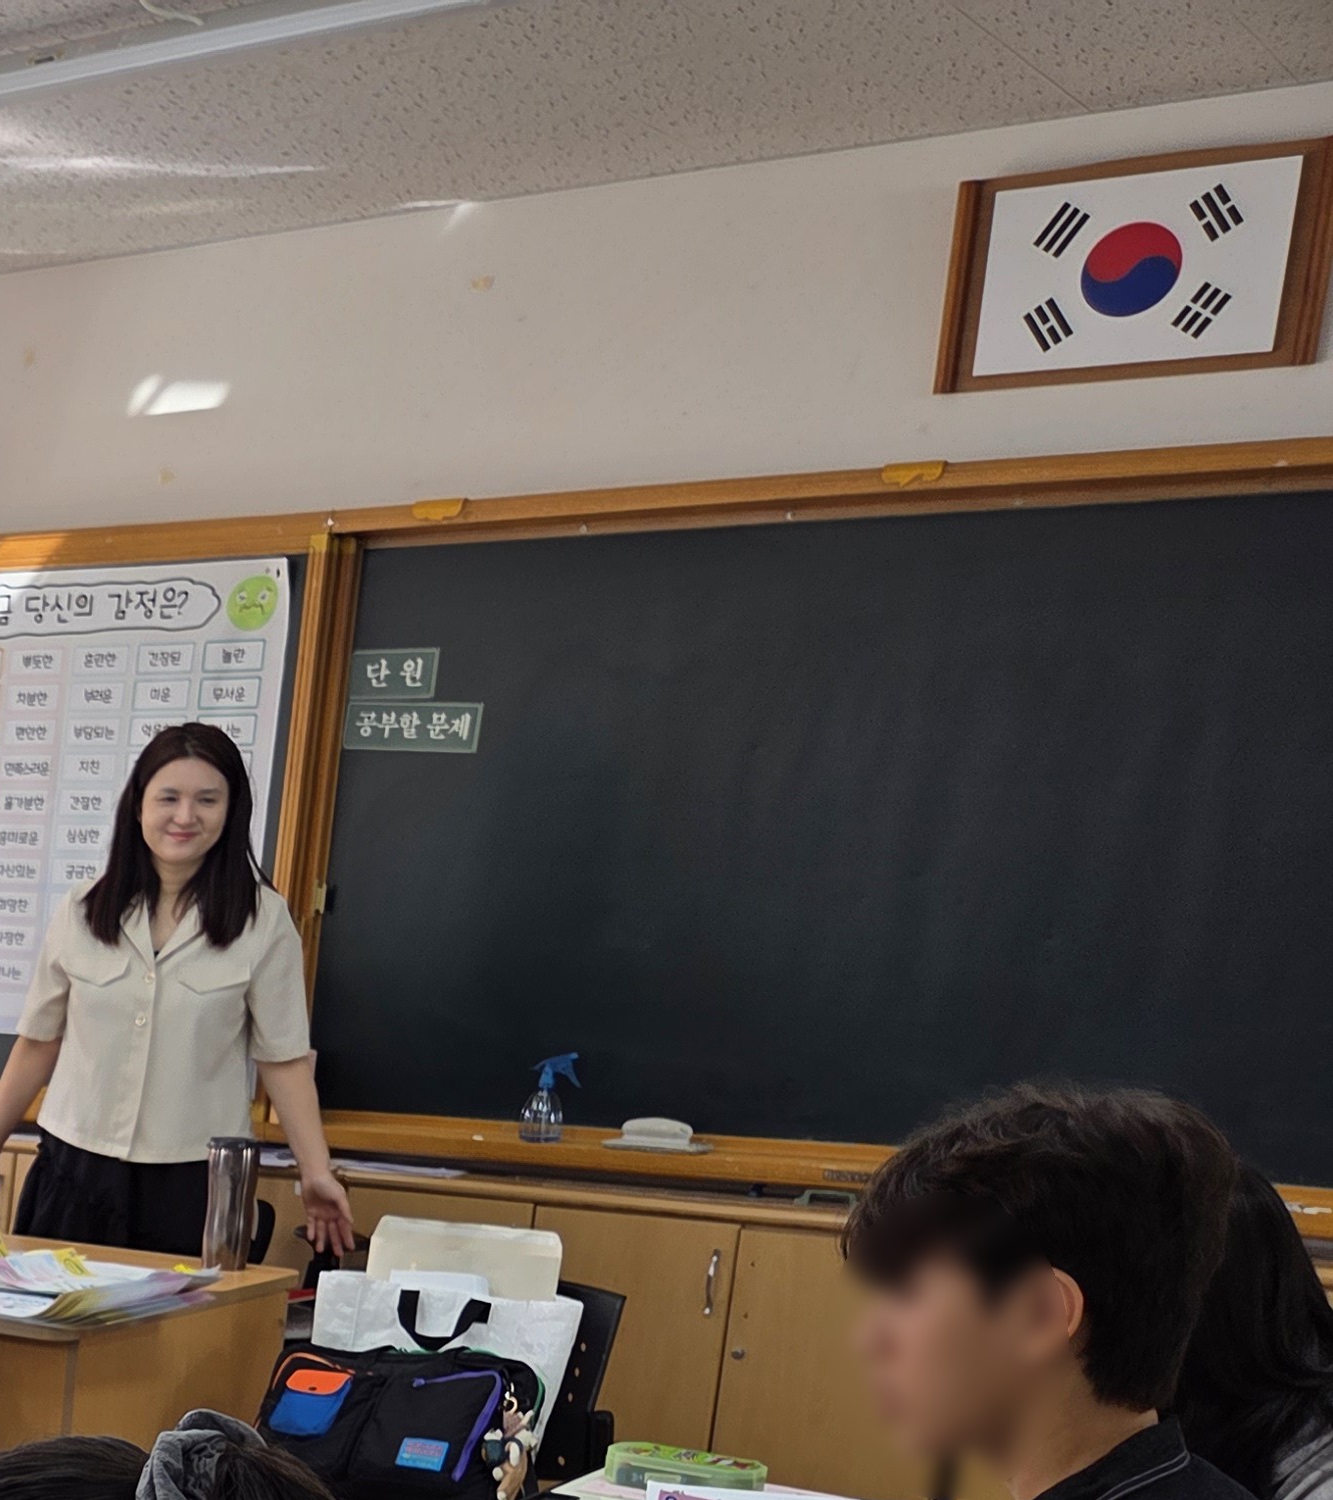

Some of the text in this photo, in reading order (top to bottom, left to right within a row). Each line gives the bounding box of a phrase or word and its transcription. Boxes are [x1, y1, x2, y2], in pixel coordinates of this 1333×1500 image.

[25, 593, 94, 624] 당신의
[108, 586, 189, 620] 감정은?
[22, 654, 54, 670] 뿌듯한
[84, 652, 116, 668] 혼란한
[148, 651, 181, 667] 긴장된
[222, 648, 245, 664] 놀란
[17, 691, 48, 707] 차분한
[84, 688, 112, 704] 부러운
[150, 687, 171, 702] 미운
[213, 686, 245, 702] 무서운
[15, 725, 47, 741] 편안한
[73, 725, 115, 740] 부담되는
[356, 711, 472, 740] 공부할 문제
[4, 761, 50, 777] 만족스러운
[78, 759, 100, 775] 지친
[4, 796, 45, 811] 홀가분한
[70, 796, 102, 811] 간절한
[66, 829, 100, 844] 심심한
[65, 864, 97, 880] 궁금한
